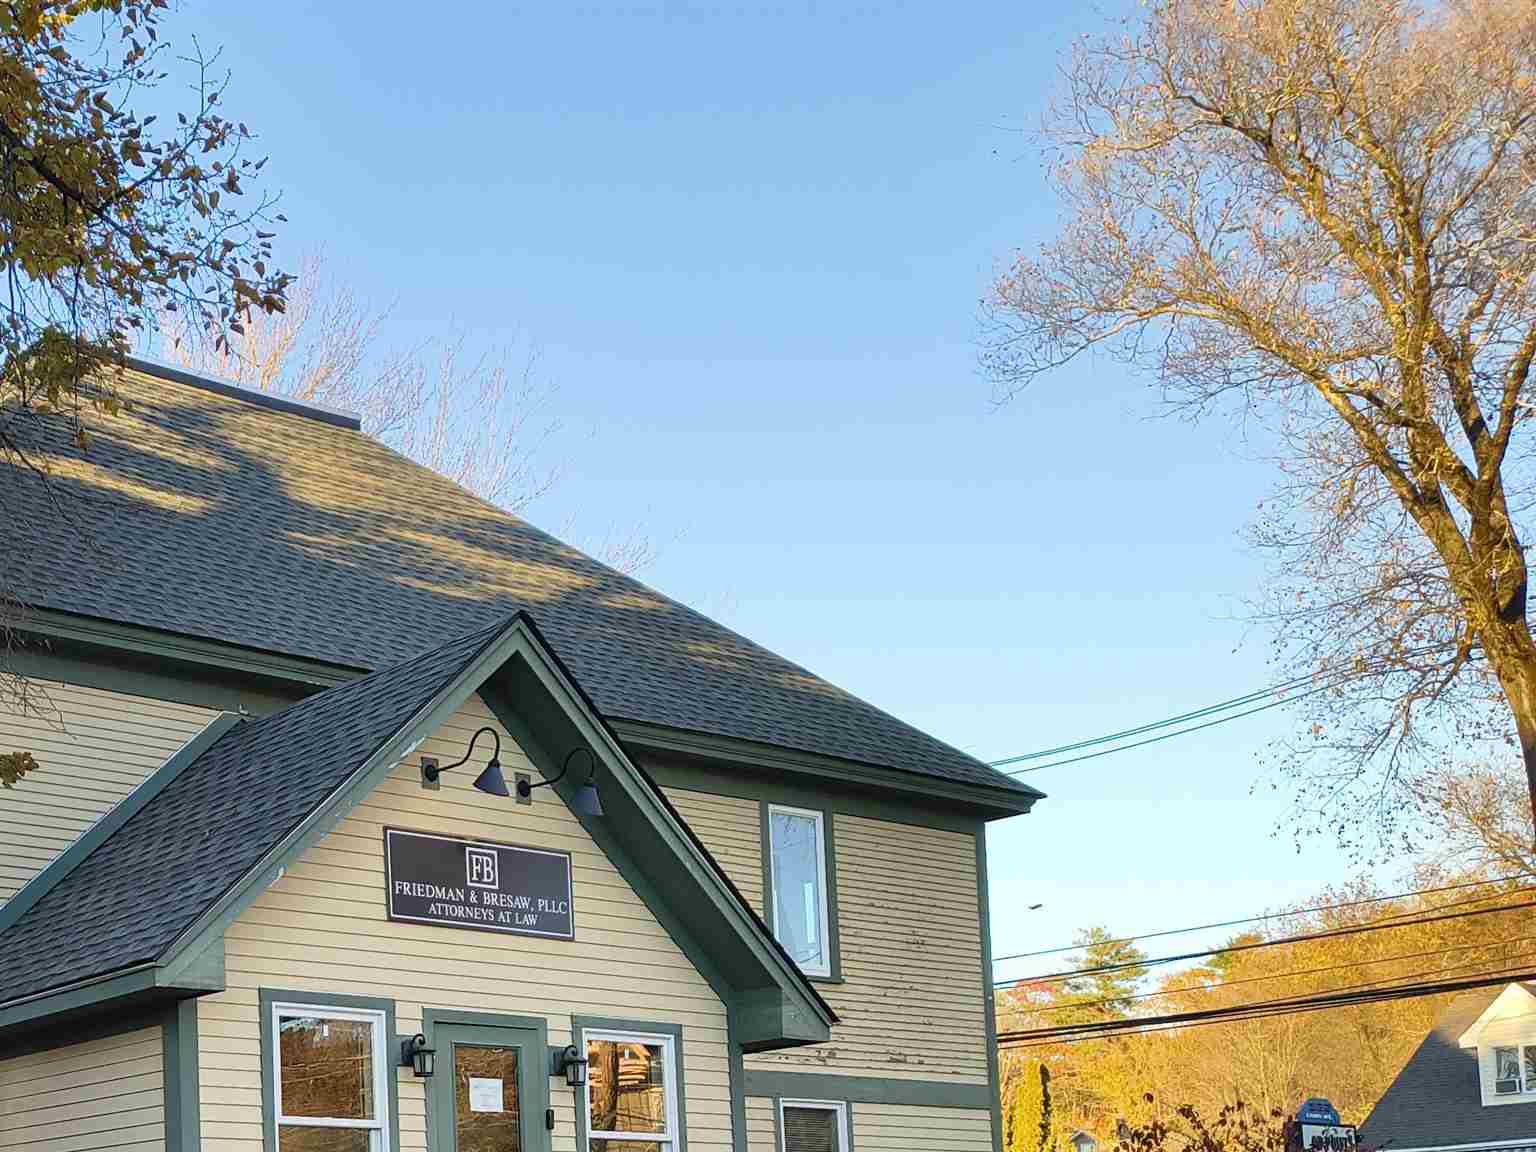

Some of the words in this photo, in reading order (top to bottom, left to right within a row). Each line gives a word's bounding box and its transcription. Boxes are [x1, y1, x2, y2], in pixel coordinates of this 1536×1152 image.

[471, 854, 494, 882] FB
[395, 880, 464, 902] FRIEDMAN
[470, 890, 478, 903] &
[483, 891, 534, 911] BRESAW,
[538, 898, 567, 914] PLLC
[428, 902, 495, 921] ATTORNEYS
[497, 912, 513, 923] AT
[515, 913, 538, 926] LAW
